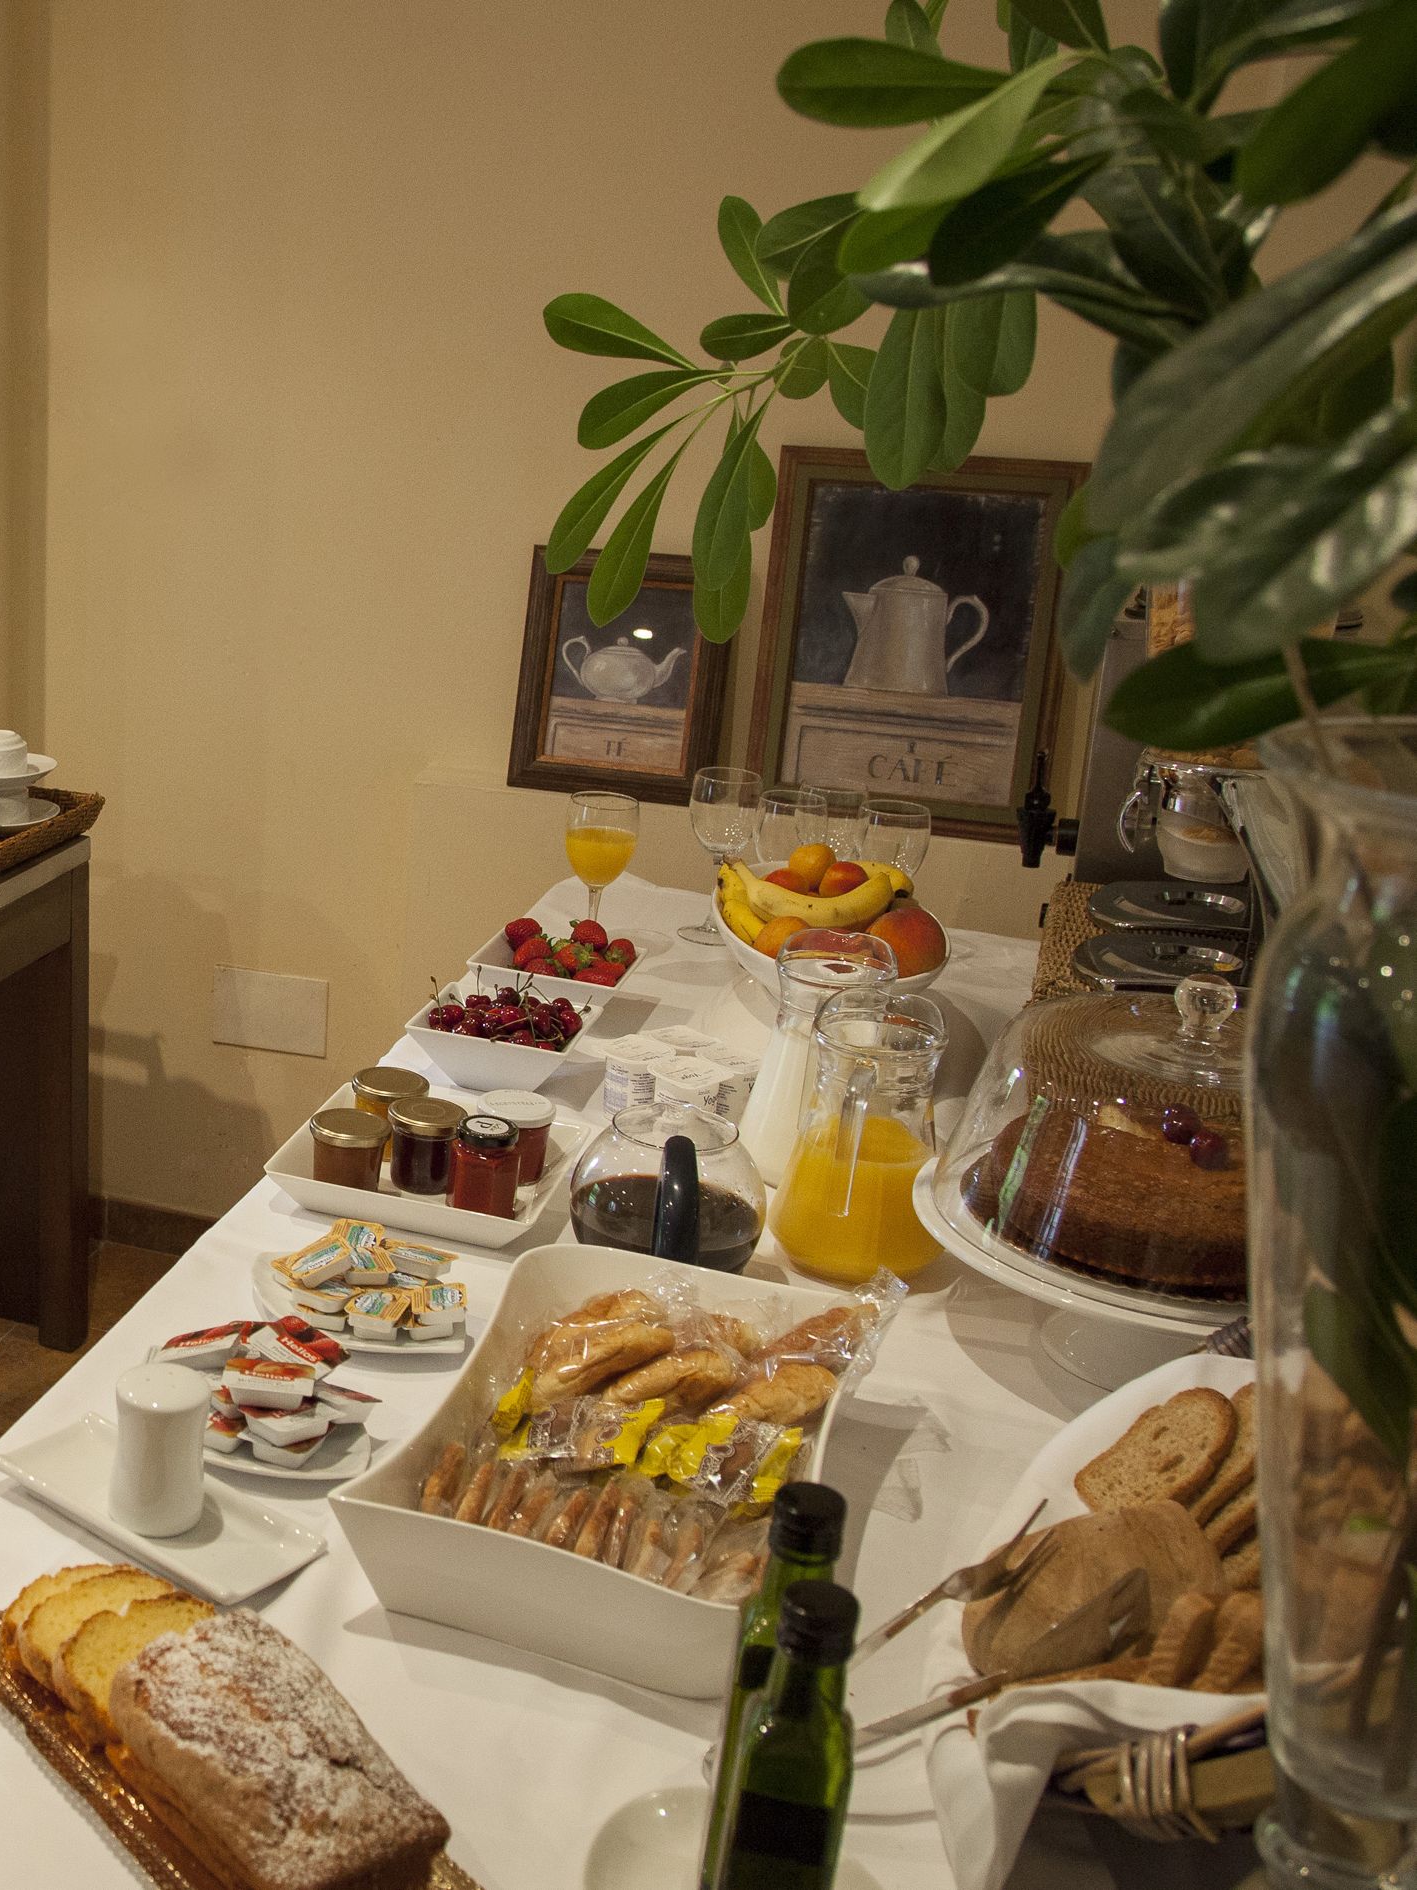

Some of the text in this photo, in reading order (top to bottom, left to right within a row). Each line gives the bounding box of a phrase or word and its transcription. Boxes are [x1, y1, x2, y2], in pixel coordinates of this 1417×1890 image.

[603, 737, 630, 757] TÉ
[868, 754, 959, 787] CAFÉ
[281, 1337, 318, 1362] Helios
